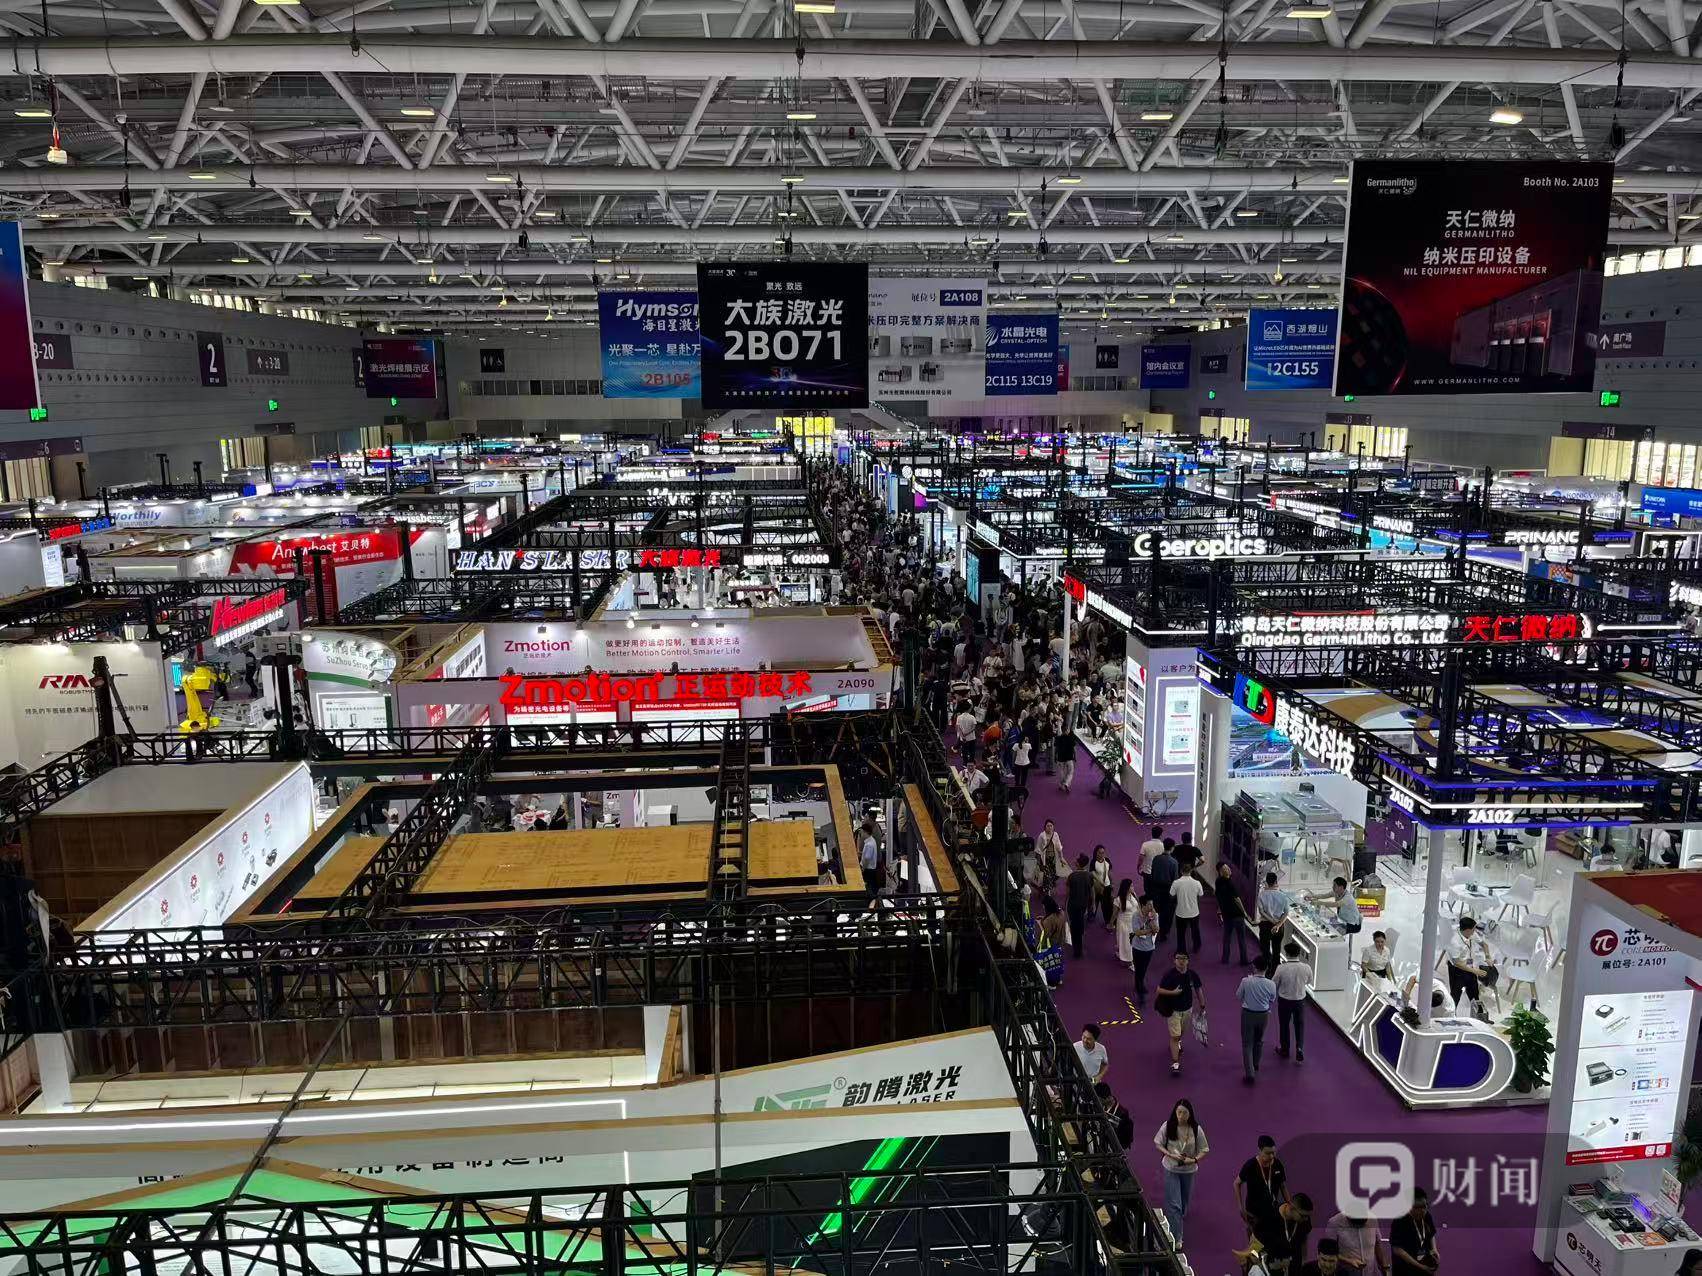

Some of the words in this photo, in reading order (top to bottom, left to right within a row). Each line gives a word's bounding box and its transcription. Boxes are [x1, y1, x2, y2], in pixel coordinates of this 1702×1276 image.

[1367, 177, 1414, 188] Germanlitho
[1523, 177, 1551, 187] Booth
[1554, 177, 1569, 187] No.
[1572, 177, 1599, 188] 2A103
[1445, 209, 1515, 229] 天仁微纳
[1444, 230, 1515, 238] GERMANLITHO
[1423, 247, 1531, 265] 纳米压印设备
[1403, 267, 1418, 276] NIL
[1421, 266, 1474, 276] EQUIPMENT
[1476, 266, 1547, 275] MANUFACTURER
[766, 282, 783, 291] 聚光
[786, 282, 803, 291] 致远
[911, 292, 936, 302] 展位号
[943, 292, 979, 302] 2A108
[724, 298, 844, 325] 大族激光
[1001, 327, 1047, 337] 水晶光电
[608, 343, 660, 357] 光聚一芯
[207, 343, 218, 373] 2
[1146, 362, 1185, 370] 馆内会议室
[1021, 375, 1053, 386] 13C19
[1373, 515, 1413, 533] PRINANO
[340, 537, 370, 552] 艾贝特
[791, 553, 829, 565] 002008
[1241, 614, 1450, 633] 青岛天仁微纳科技股份有限公司
[1463, 613, 1578, 641] 天仁微纳
[1241, 633, 1300, 647] Qingdao
[1303, 632, 1391, 646] GermanLitho
[1393, 633, 1419, 645] Co.,
[1422, 631, 1448, 644] Ltd.
[504, 640, 571, 652] Zmotion
[606, 649, 631, 657] Better
[634, 649, 659, 657] Motion
[661, 648, 691, 657] Control,
[693, 647, 725, 656] Smarter
[726, 647, 741, 655] Life
[327, 656, 352, 667] SuZhou
[1161, 665, 1195, 673] 以客户为
[499, 673, 660, 704] Zmotion
[674, 671, 812, 698] 正运动技术
[837, 678, 875, 689] 2A090
[1467, 810, 1513, 824] 2A102
[1601, 959, 1636, 970] 展位号:
[1637, 957, 1667, 968] 2A101
[842, 1065, 963, 1107] 韵腾激光
